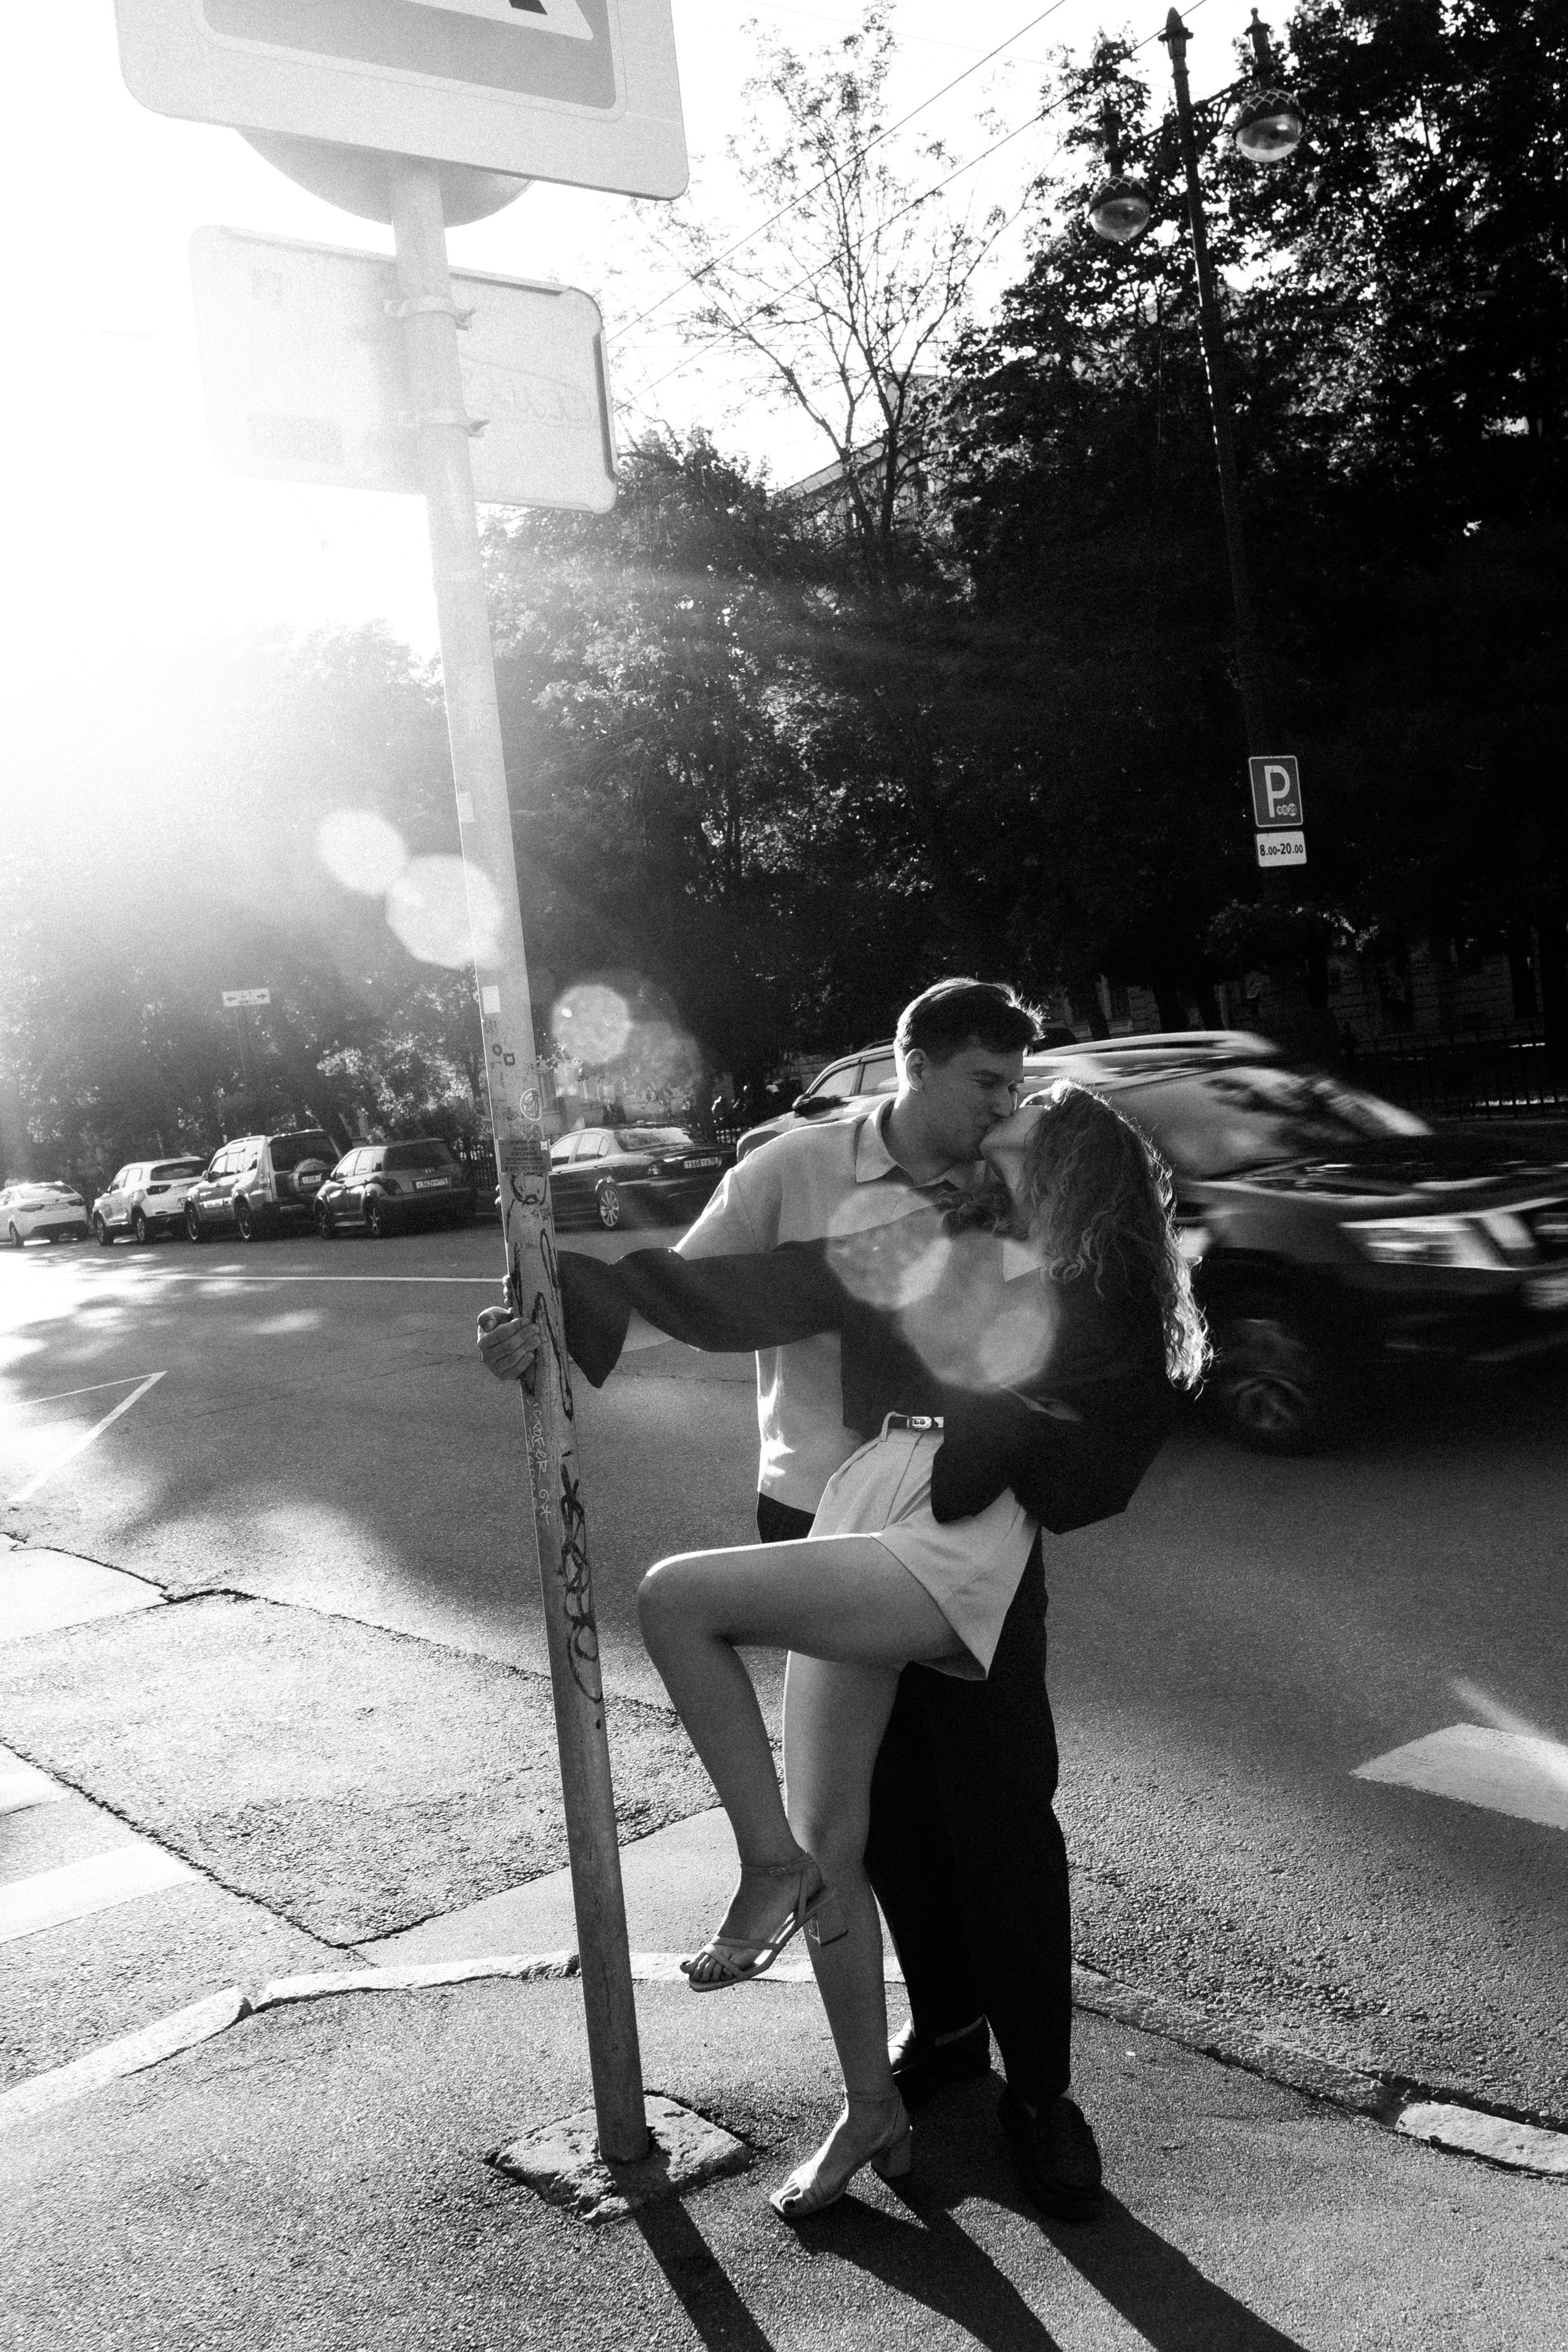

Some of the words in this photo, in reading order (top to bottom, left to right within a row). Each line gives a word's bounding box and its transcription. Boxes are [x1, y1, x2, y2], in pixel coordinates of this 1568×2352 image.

[1264, 765, 1290, 818] P
[1289, 805, 1297, 814] 20
[1260, 843, 1303, 856] 8.00-20.00
